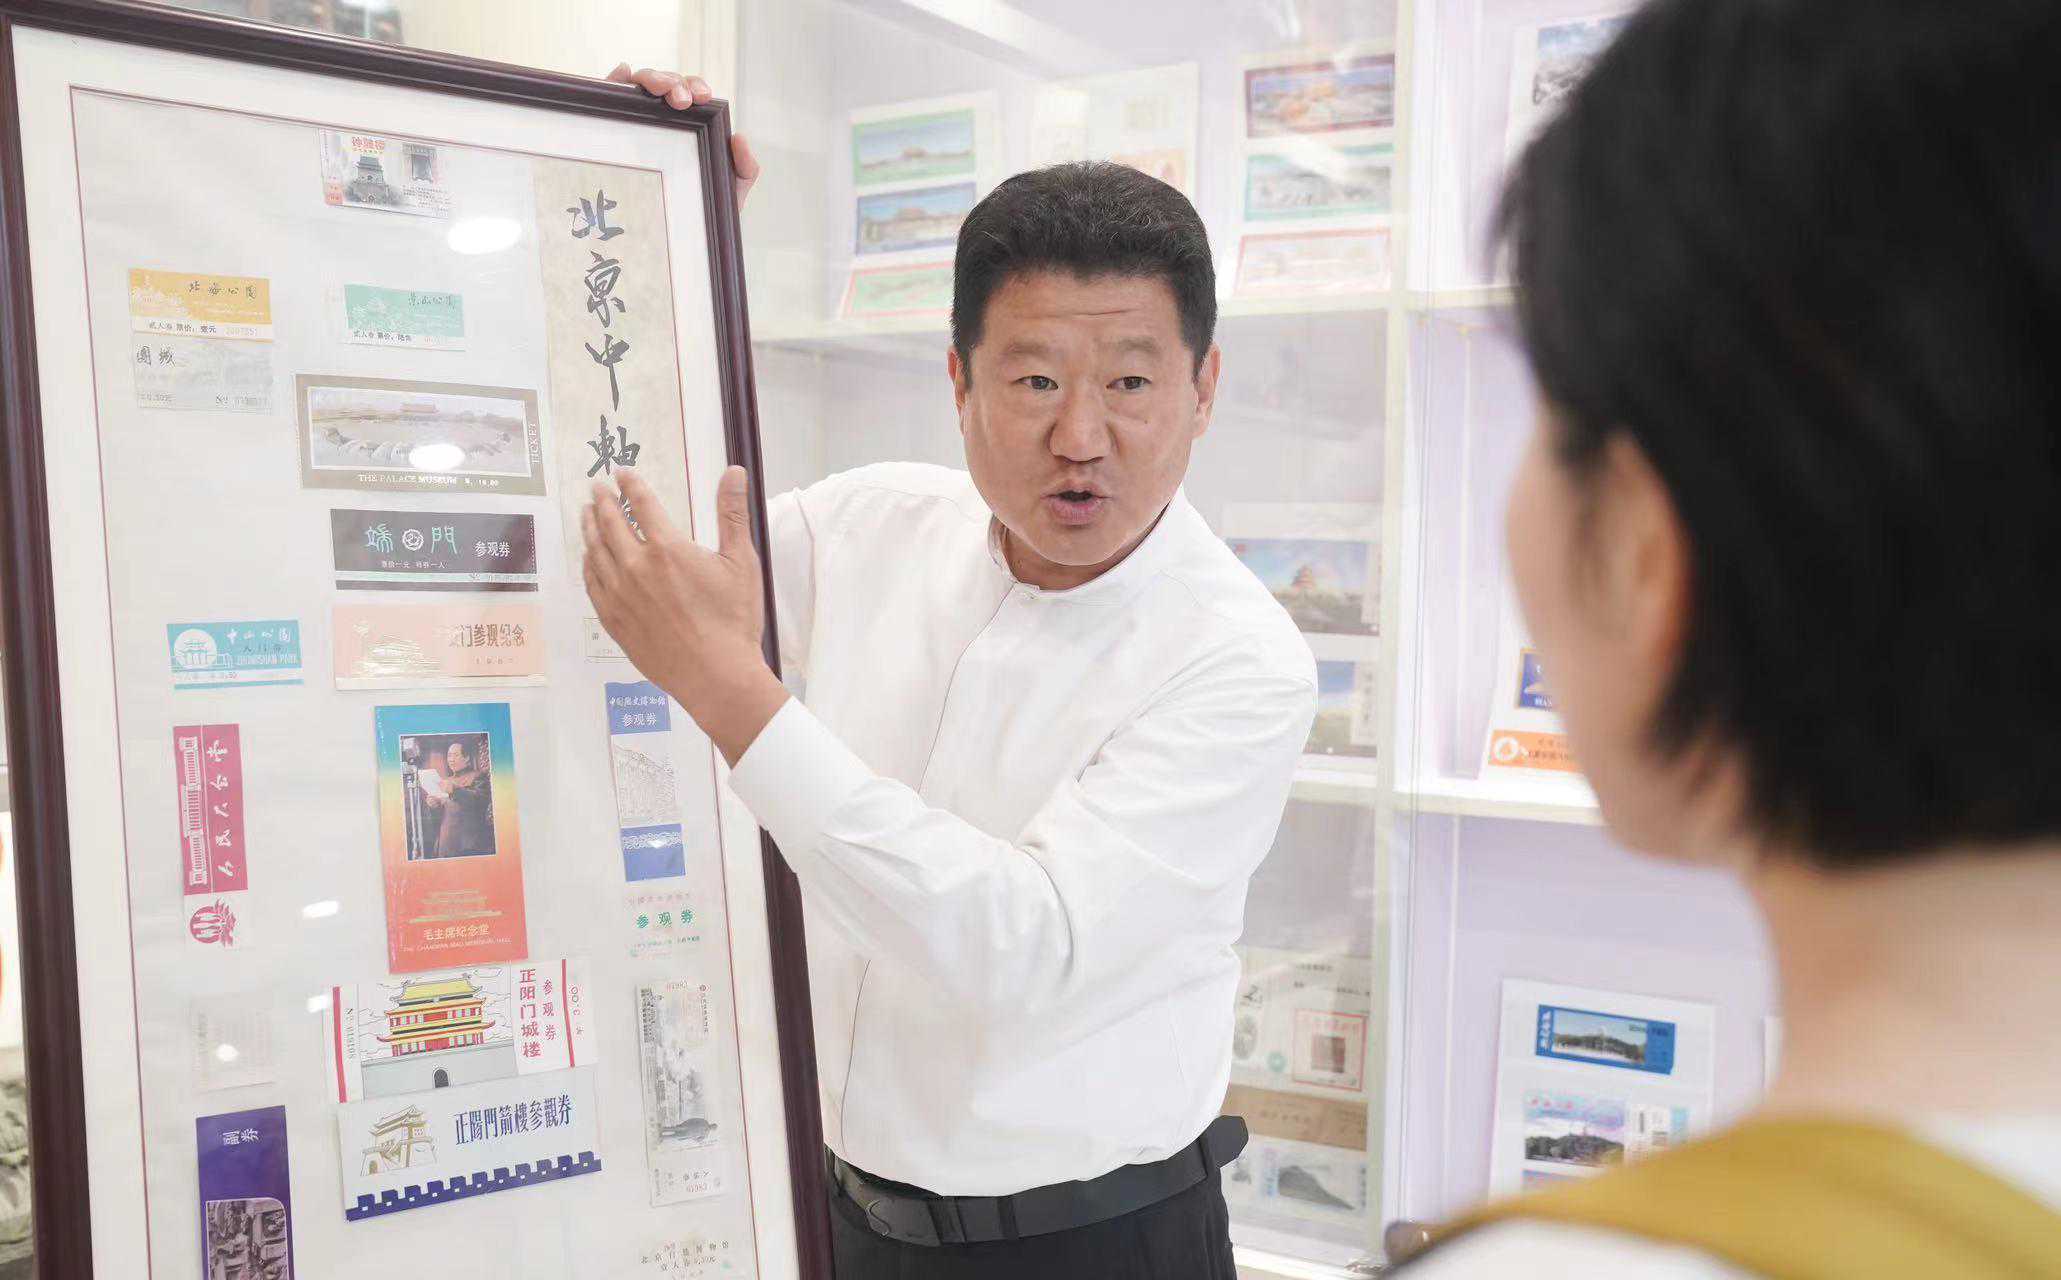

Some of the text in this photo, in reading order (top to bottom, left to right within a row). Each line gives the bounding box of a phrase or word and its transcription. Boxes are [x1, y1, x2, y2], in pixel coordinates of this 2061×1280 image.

[566, 188, 647, 543] 北京中軸
[358, 474, 377, 482] THE
[380, 475, 416, 484] PALACE
[417, 476, 457, 486] MUSEUM
[474, 541, 511, 558] 参观券
[637, 909, 694, 928] 参观券
[423, 923, 490, 940] 毛主席纪念堂
[520, 969, 542, 1058] 正阳门城楼
[543, 979, 556, 1041] 参观券
[222, 1128, 259, 1146] 副券
